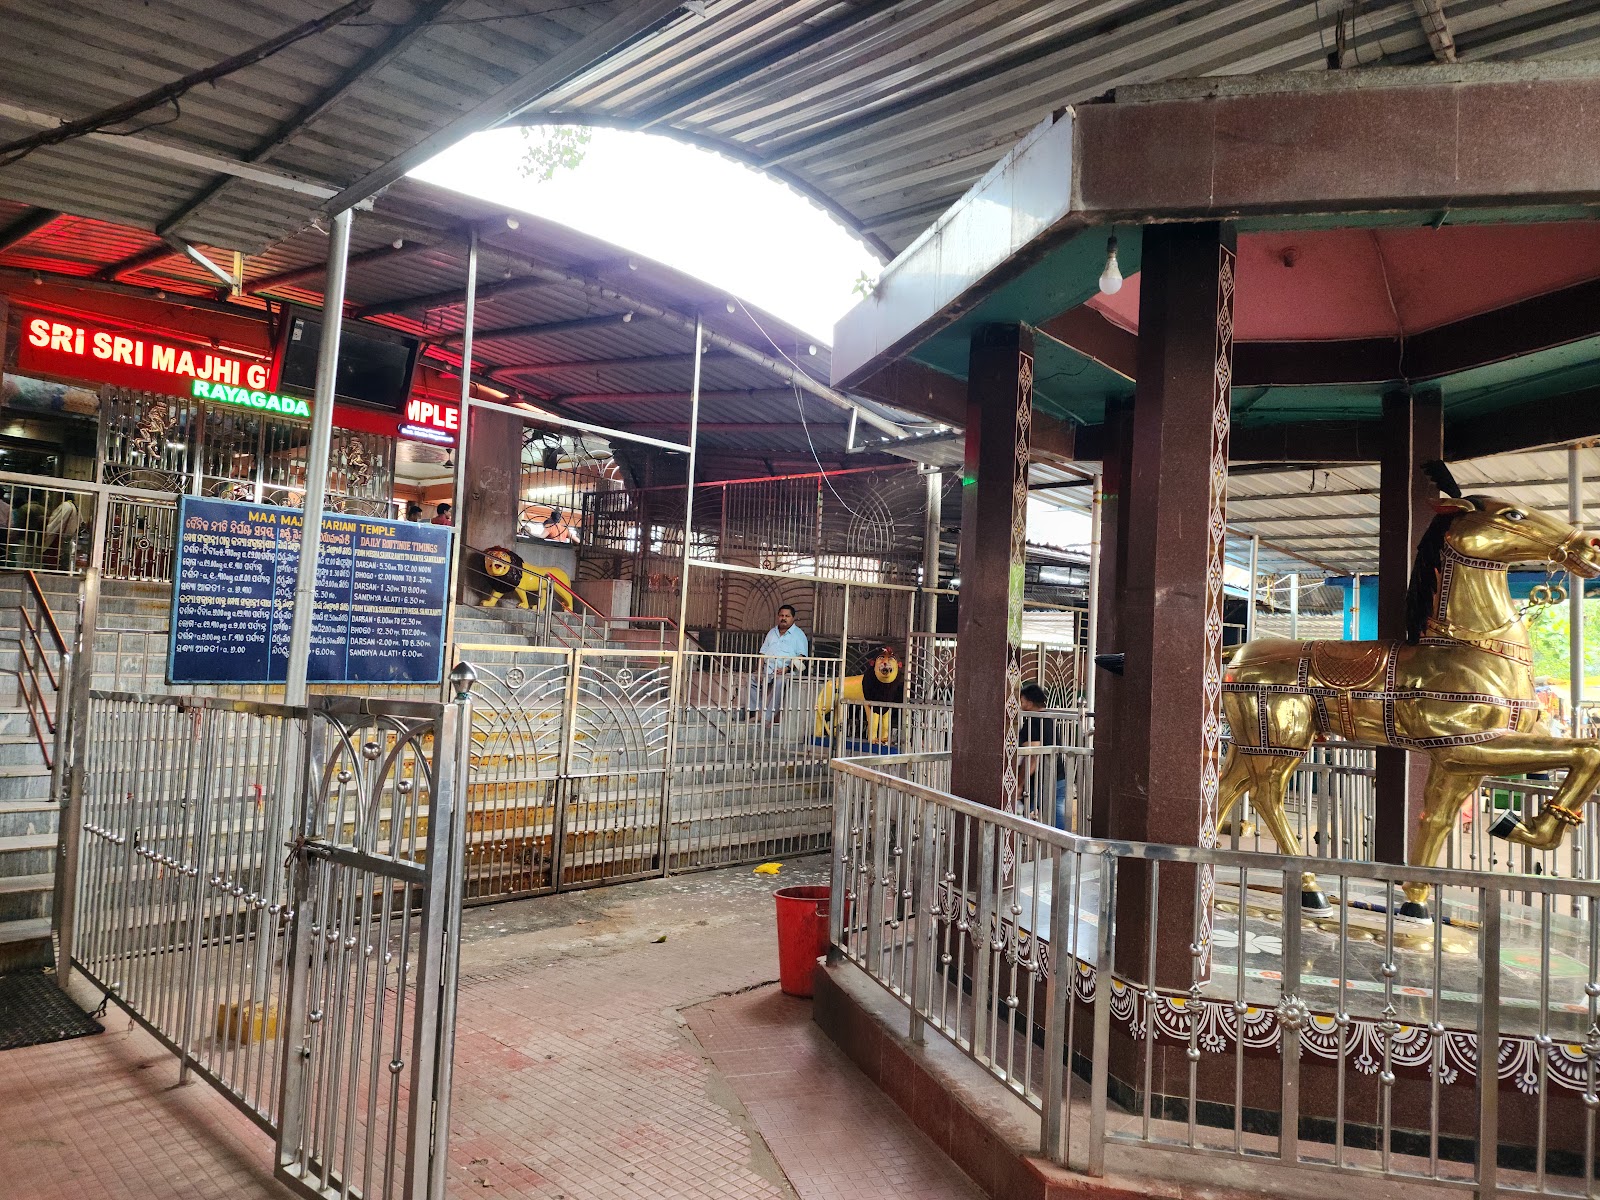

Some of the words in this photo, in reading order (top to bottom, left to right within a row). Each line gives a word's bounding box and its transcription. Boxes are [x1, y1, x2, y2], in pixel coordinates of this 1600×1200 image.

[93, 332, 144, 367] SRI
[151, 345, 240, 386] MAJHI
[192, 379, 311, 418] RAYAGADA
[407, 399, 459, 430] MPLE
[248, 511, 277, 523] MAA
[360, 523, 396, 536] TEMPLE
[360, 536, 382, 548] DAILY
[412, 541, 438, 554] TIMINGS
[355, 571, 374, 580] BHOGO
[354, 593, 381, 602] SANDHYA
[382, 595, 400, 603] ALATI
[351, 615, 373, 623] DARSAN
[350, 626, 371, 634] BHOGO
[376, 627, 393, 635] 12.30
[350, 637, 375, 645] DARSAN
[349, 648, 377, 657] SANDHYA
[379, 649, 398, 657] ALATI
